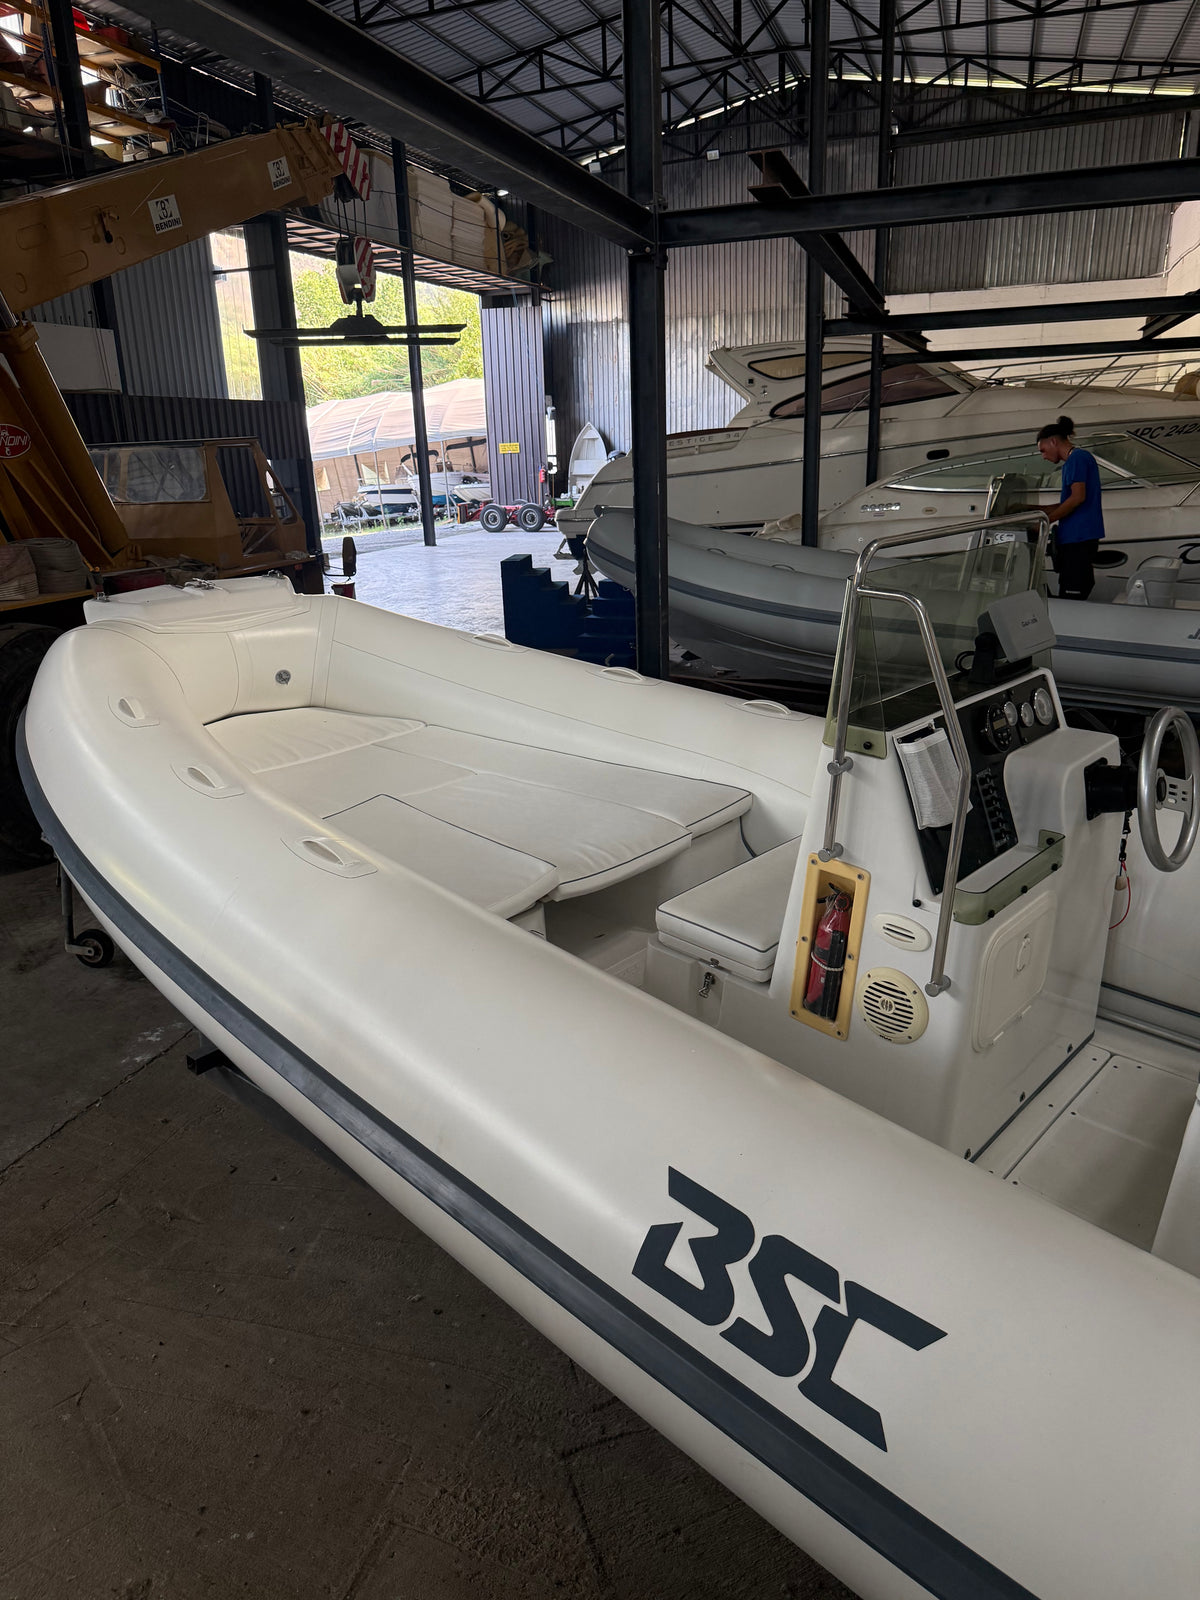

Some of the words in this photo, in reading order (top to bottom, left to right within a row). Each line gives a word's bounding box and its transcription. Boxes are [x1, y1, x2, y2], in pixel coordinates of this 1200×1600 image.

[155, 217, 181, 232] BENDINI
[0, 435, 28, 446] NDINI
[668, 435, 714, 447] ESTIGE
[631, 1165, 948, 1453] BSC
